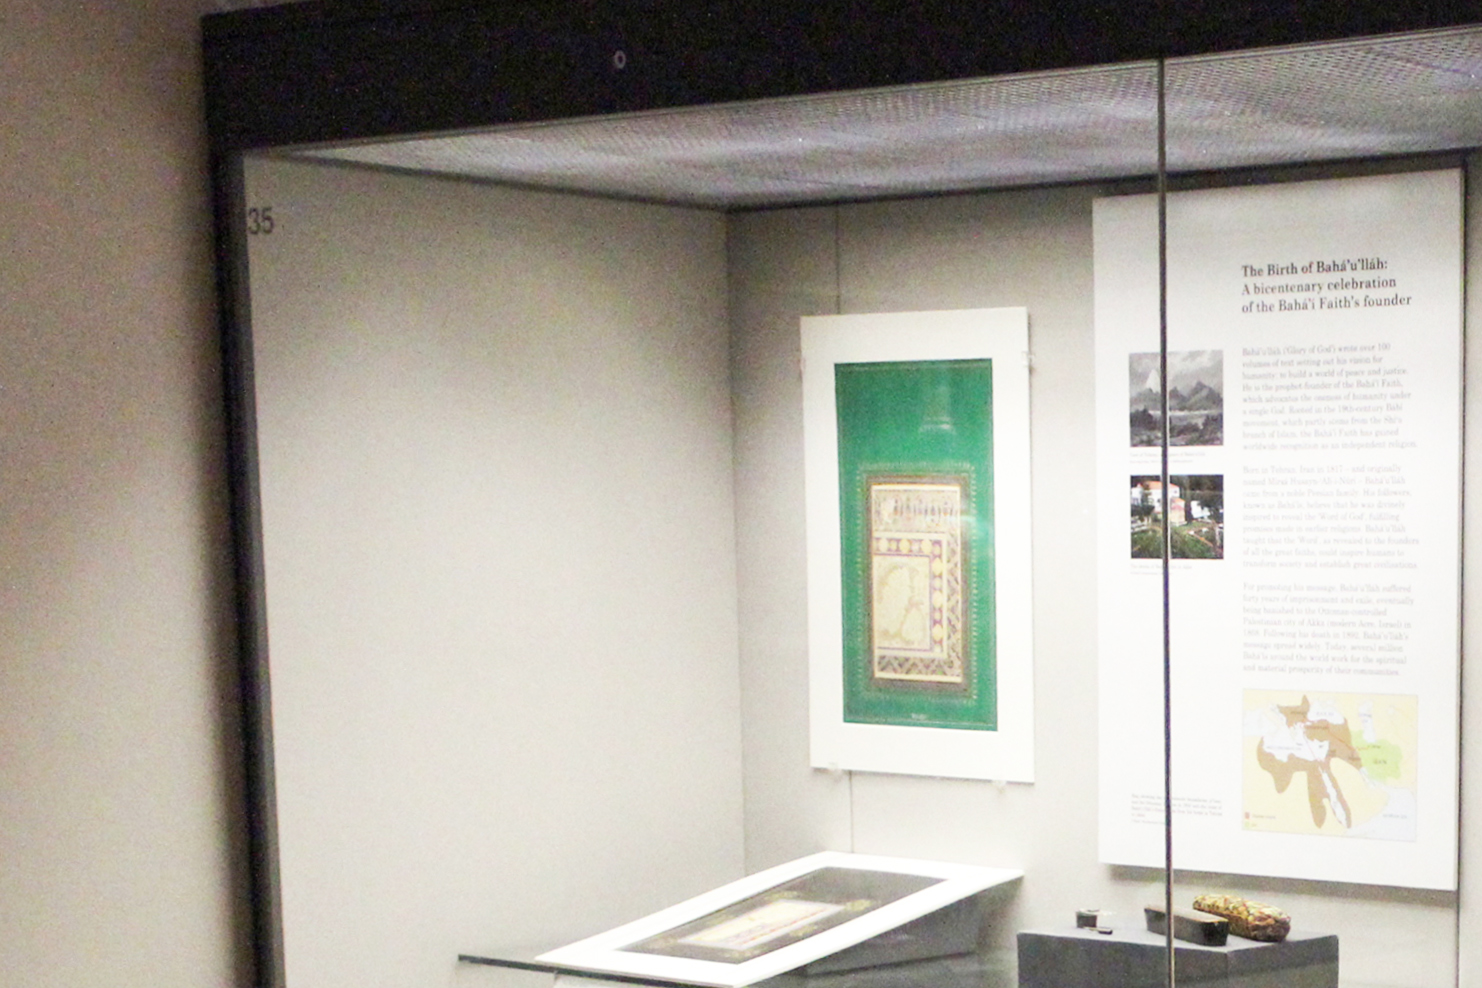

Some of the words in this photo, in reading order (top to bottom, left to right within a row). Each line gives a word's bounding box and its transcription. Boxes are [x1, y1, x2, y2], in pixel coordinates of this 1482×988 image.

[247, 207, 275, 235] 35
[1242, 265, 1263, 277] The
[1268, 263, 1297, 276] Birth
[1302, 262, 1314, 274] of
[1242, 284, 1251, 295] A
[1254, 280, 1323, 294] bicentenary
[1327, 276, 1396, 291] celebration
[1242, 302, 1255, 313] of
[1257, 300, 1274, 312] the
[1319, 295, 1360, 310] Faith's
[1364, 293, 1412, 307] founder
